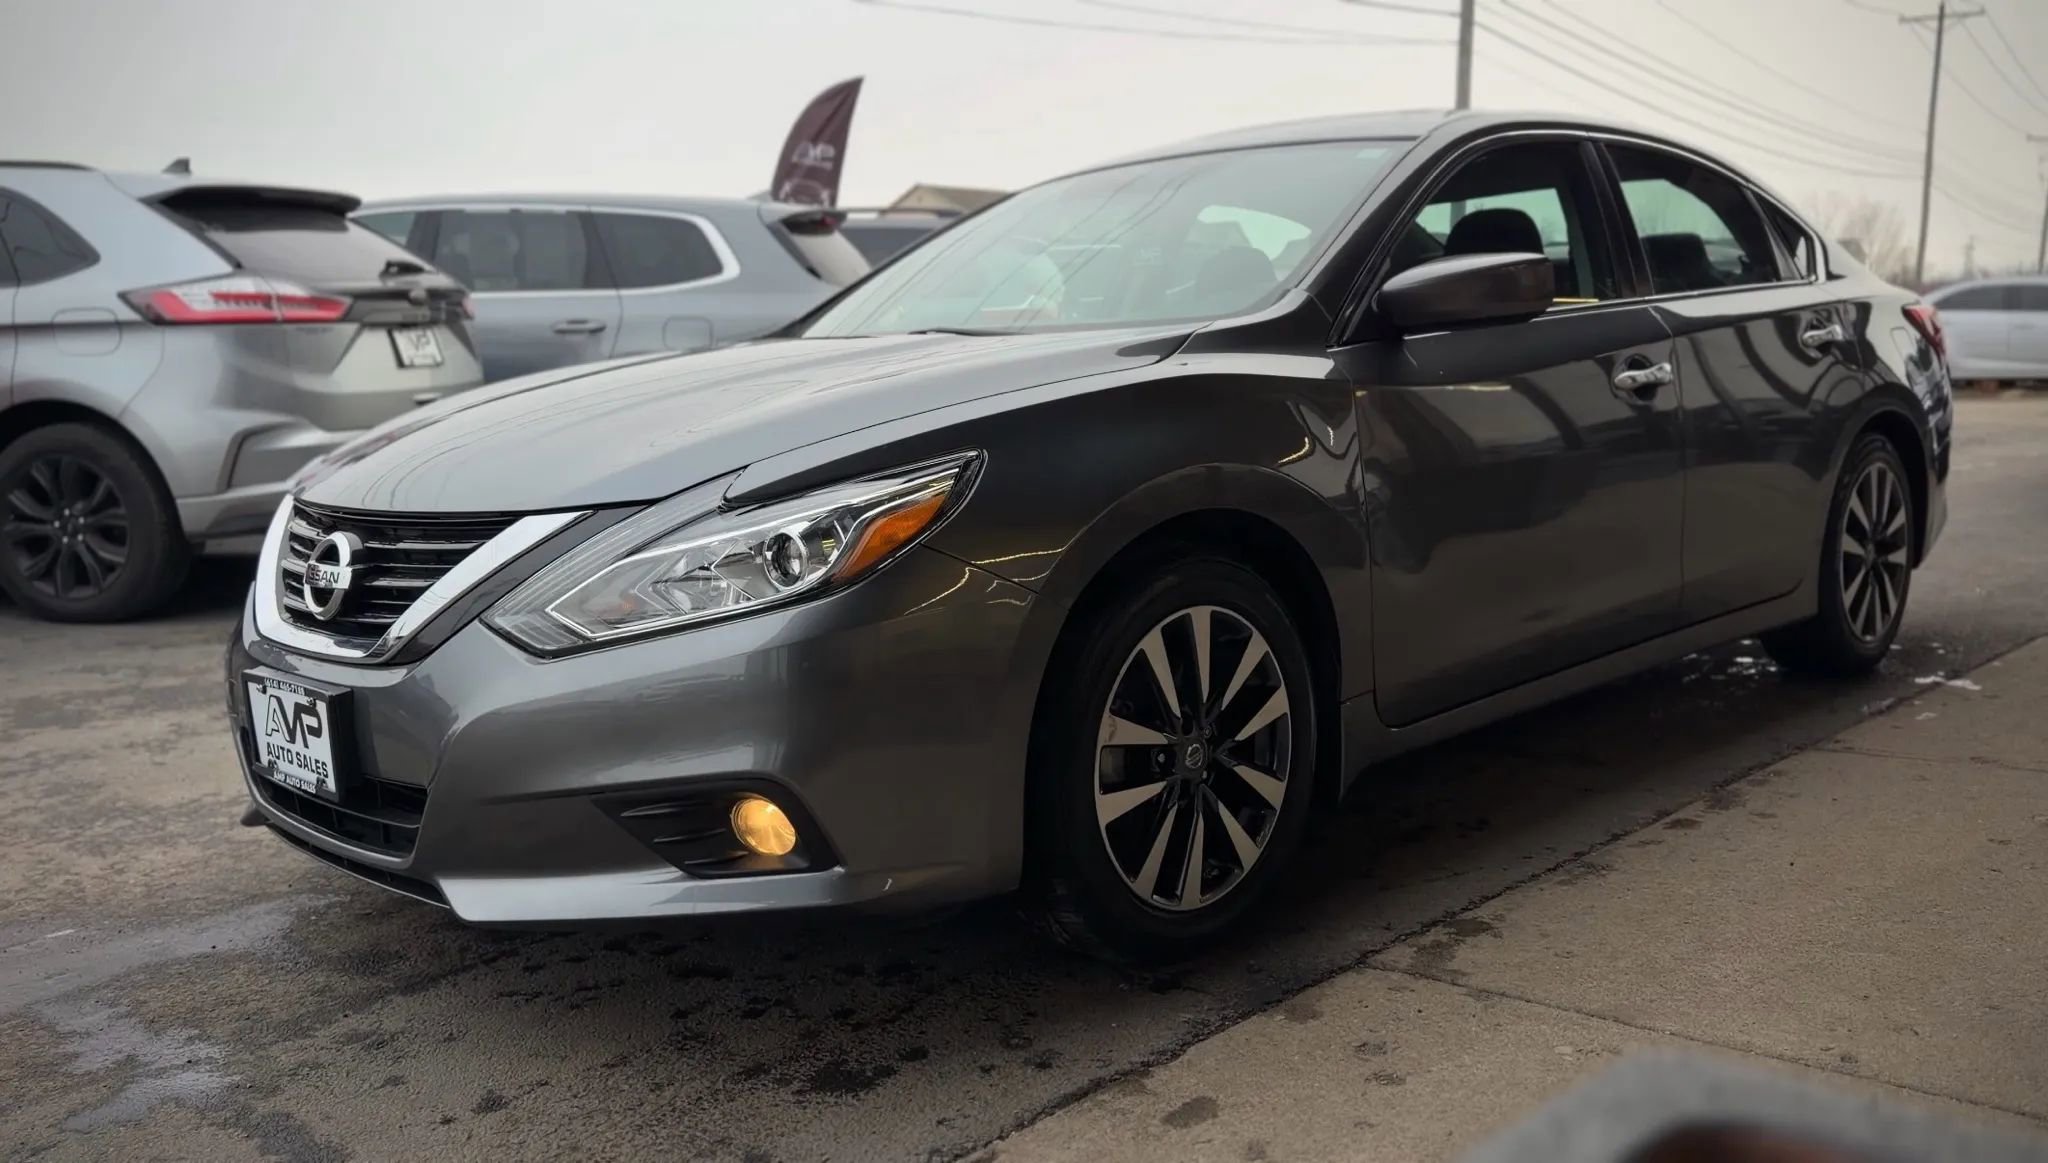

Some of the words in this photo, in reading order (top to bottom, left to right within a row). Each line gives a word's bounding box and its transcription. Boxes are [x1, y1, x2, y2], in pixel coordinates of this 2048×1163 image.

[267, 742, 294, 765] AUTO
[295, 751, 329, 779] SALES
[286, 774, 300, 788] AUTO
[300, 779, 316, 794] SALES
